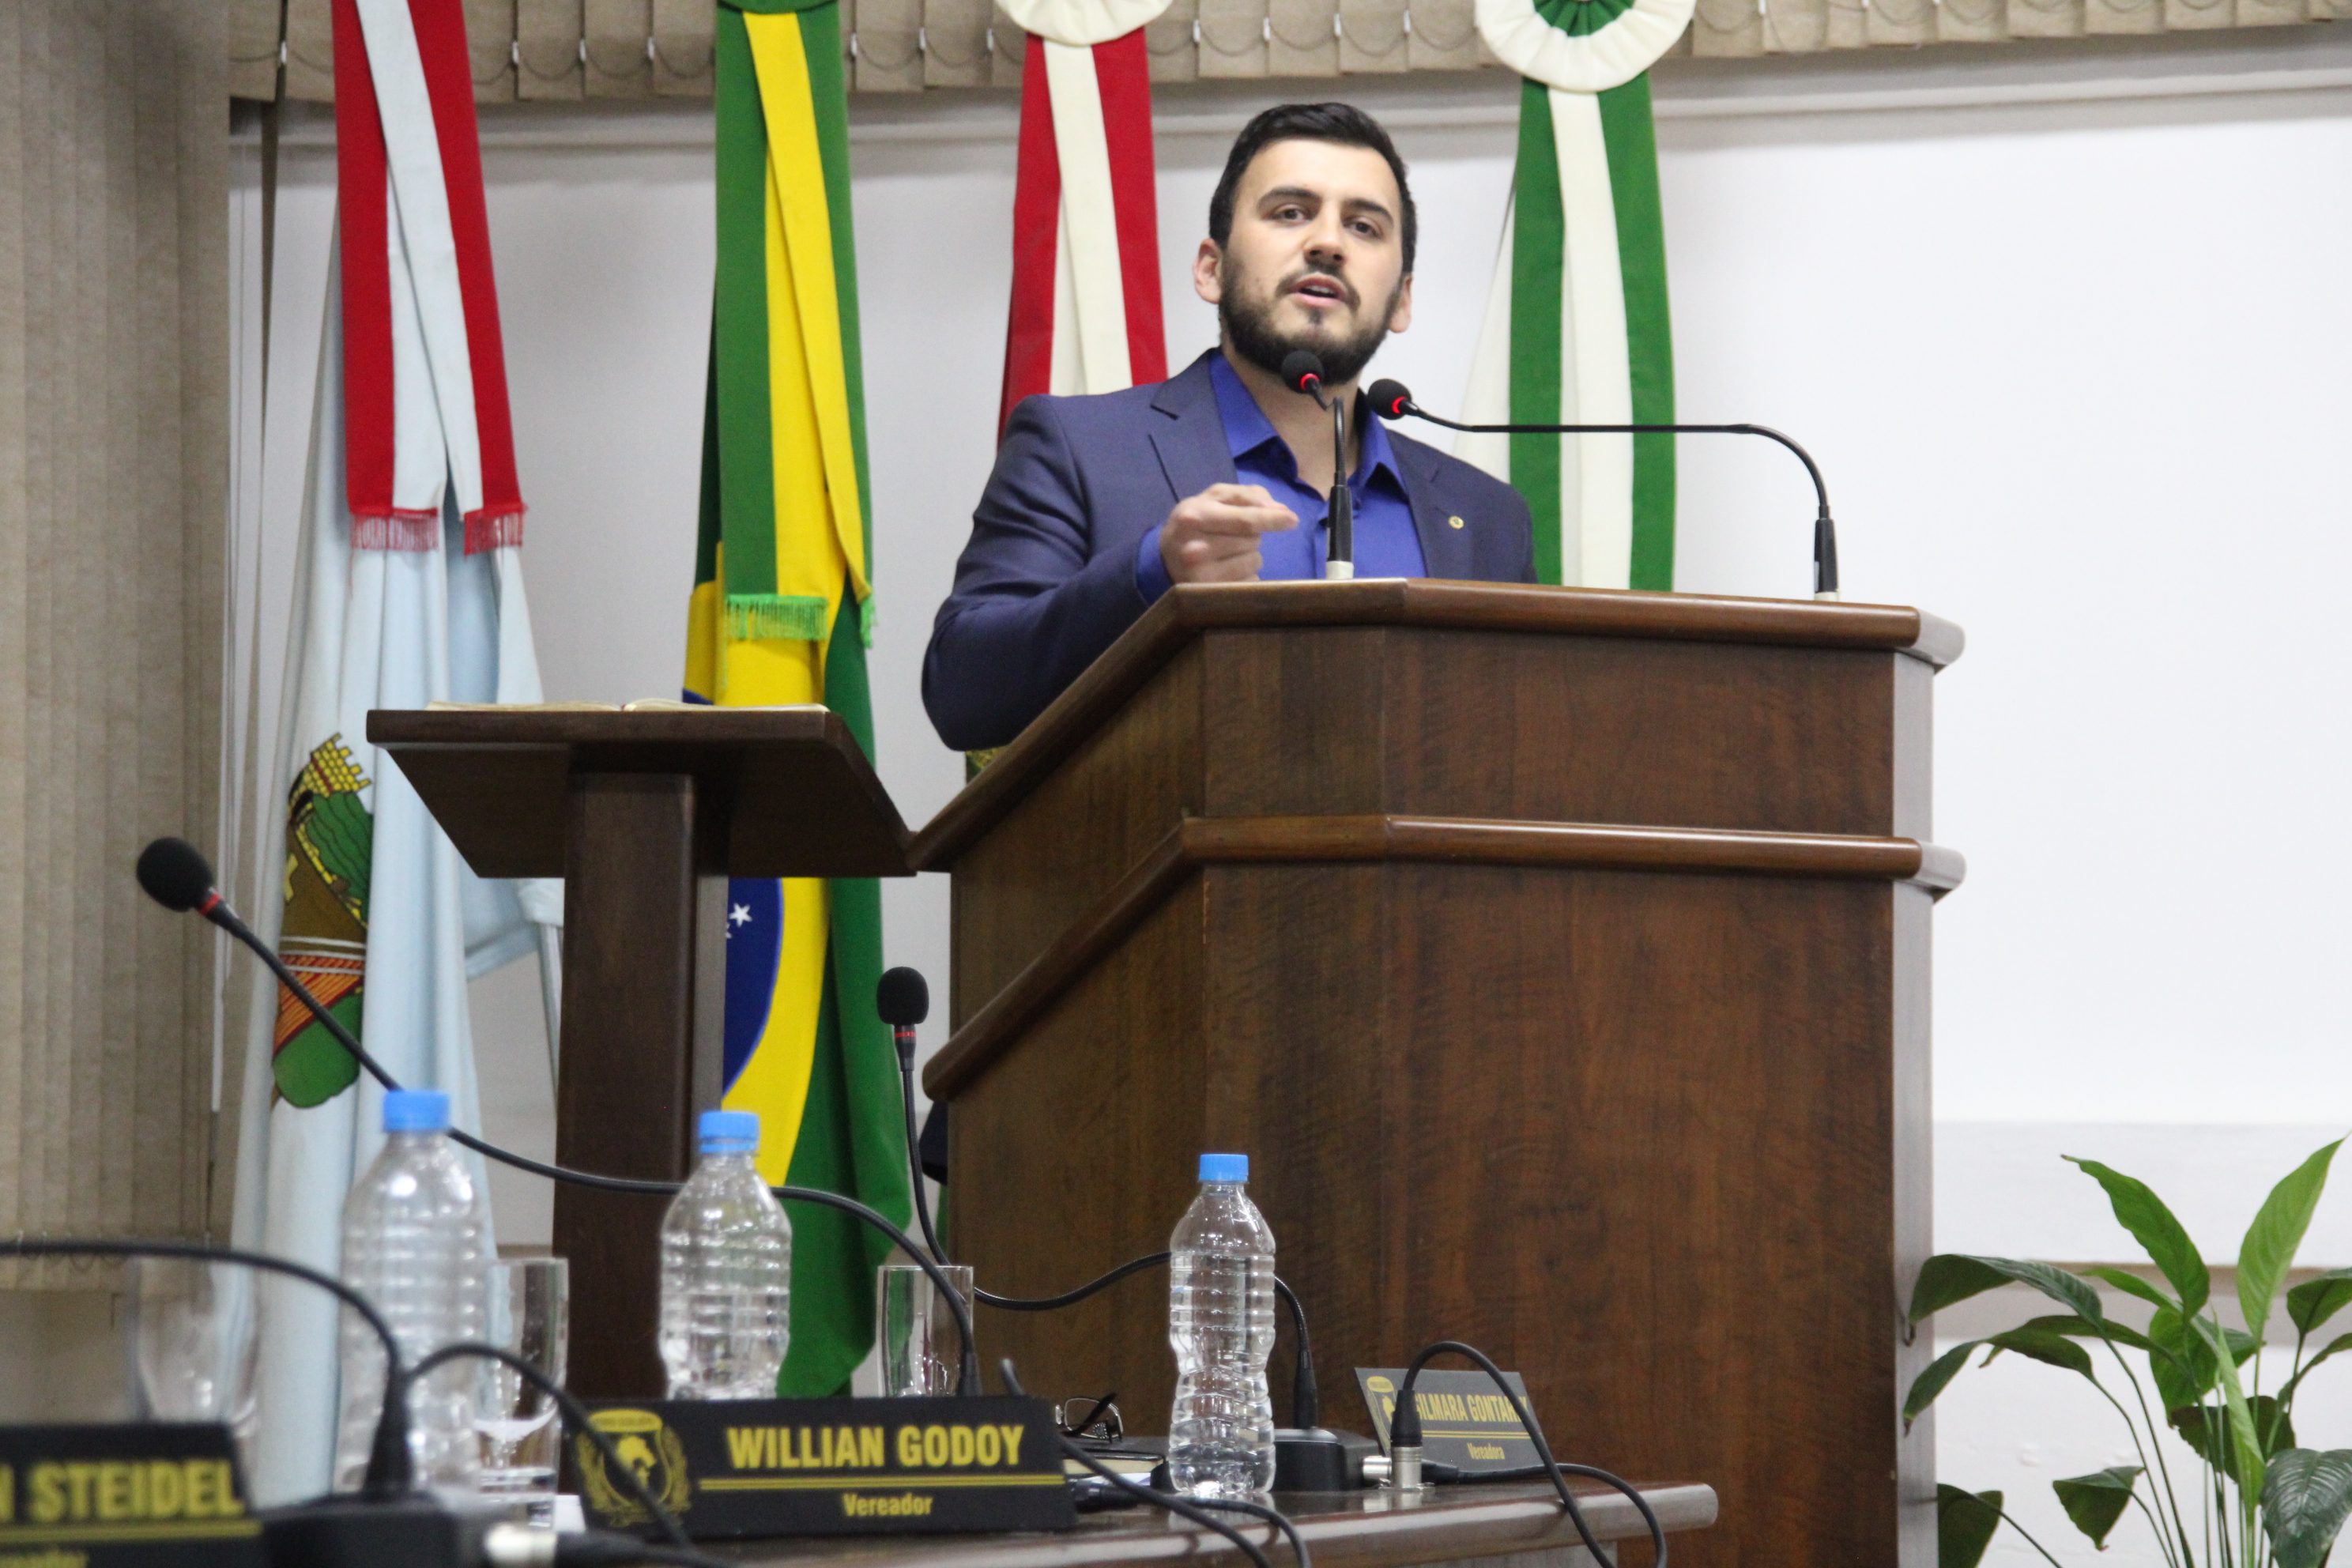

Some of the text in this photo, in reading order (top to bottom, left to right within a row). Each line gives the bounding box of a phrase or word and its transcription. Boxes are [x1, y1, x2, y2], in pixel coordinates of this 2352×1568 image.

[1467, 1394, 1528, 1423] GONTAR
[726, 1425, 1025, 1469] WILLIAN GODOY
[1467, 1442, 1506, 1460] Vereadora
[28, 1461, 247, 1522] STEIDEL
[842, 1492, 934, 1517] Vereador
